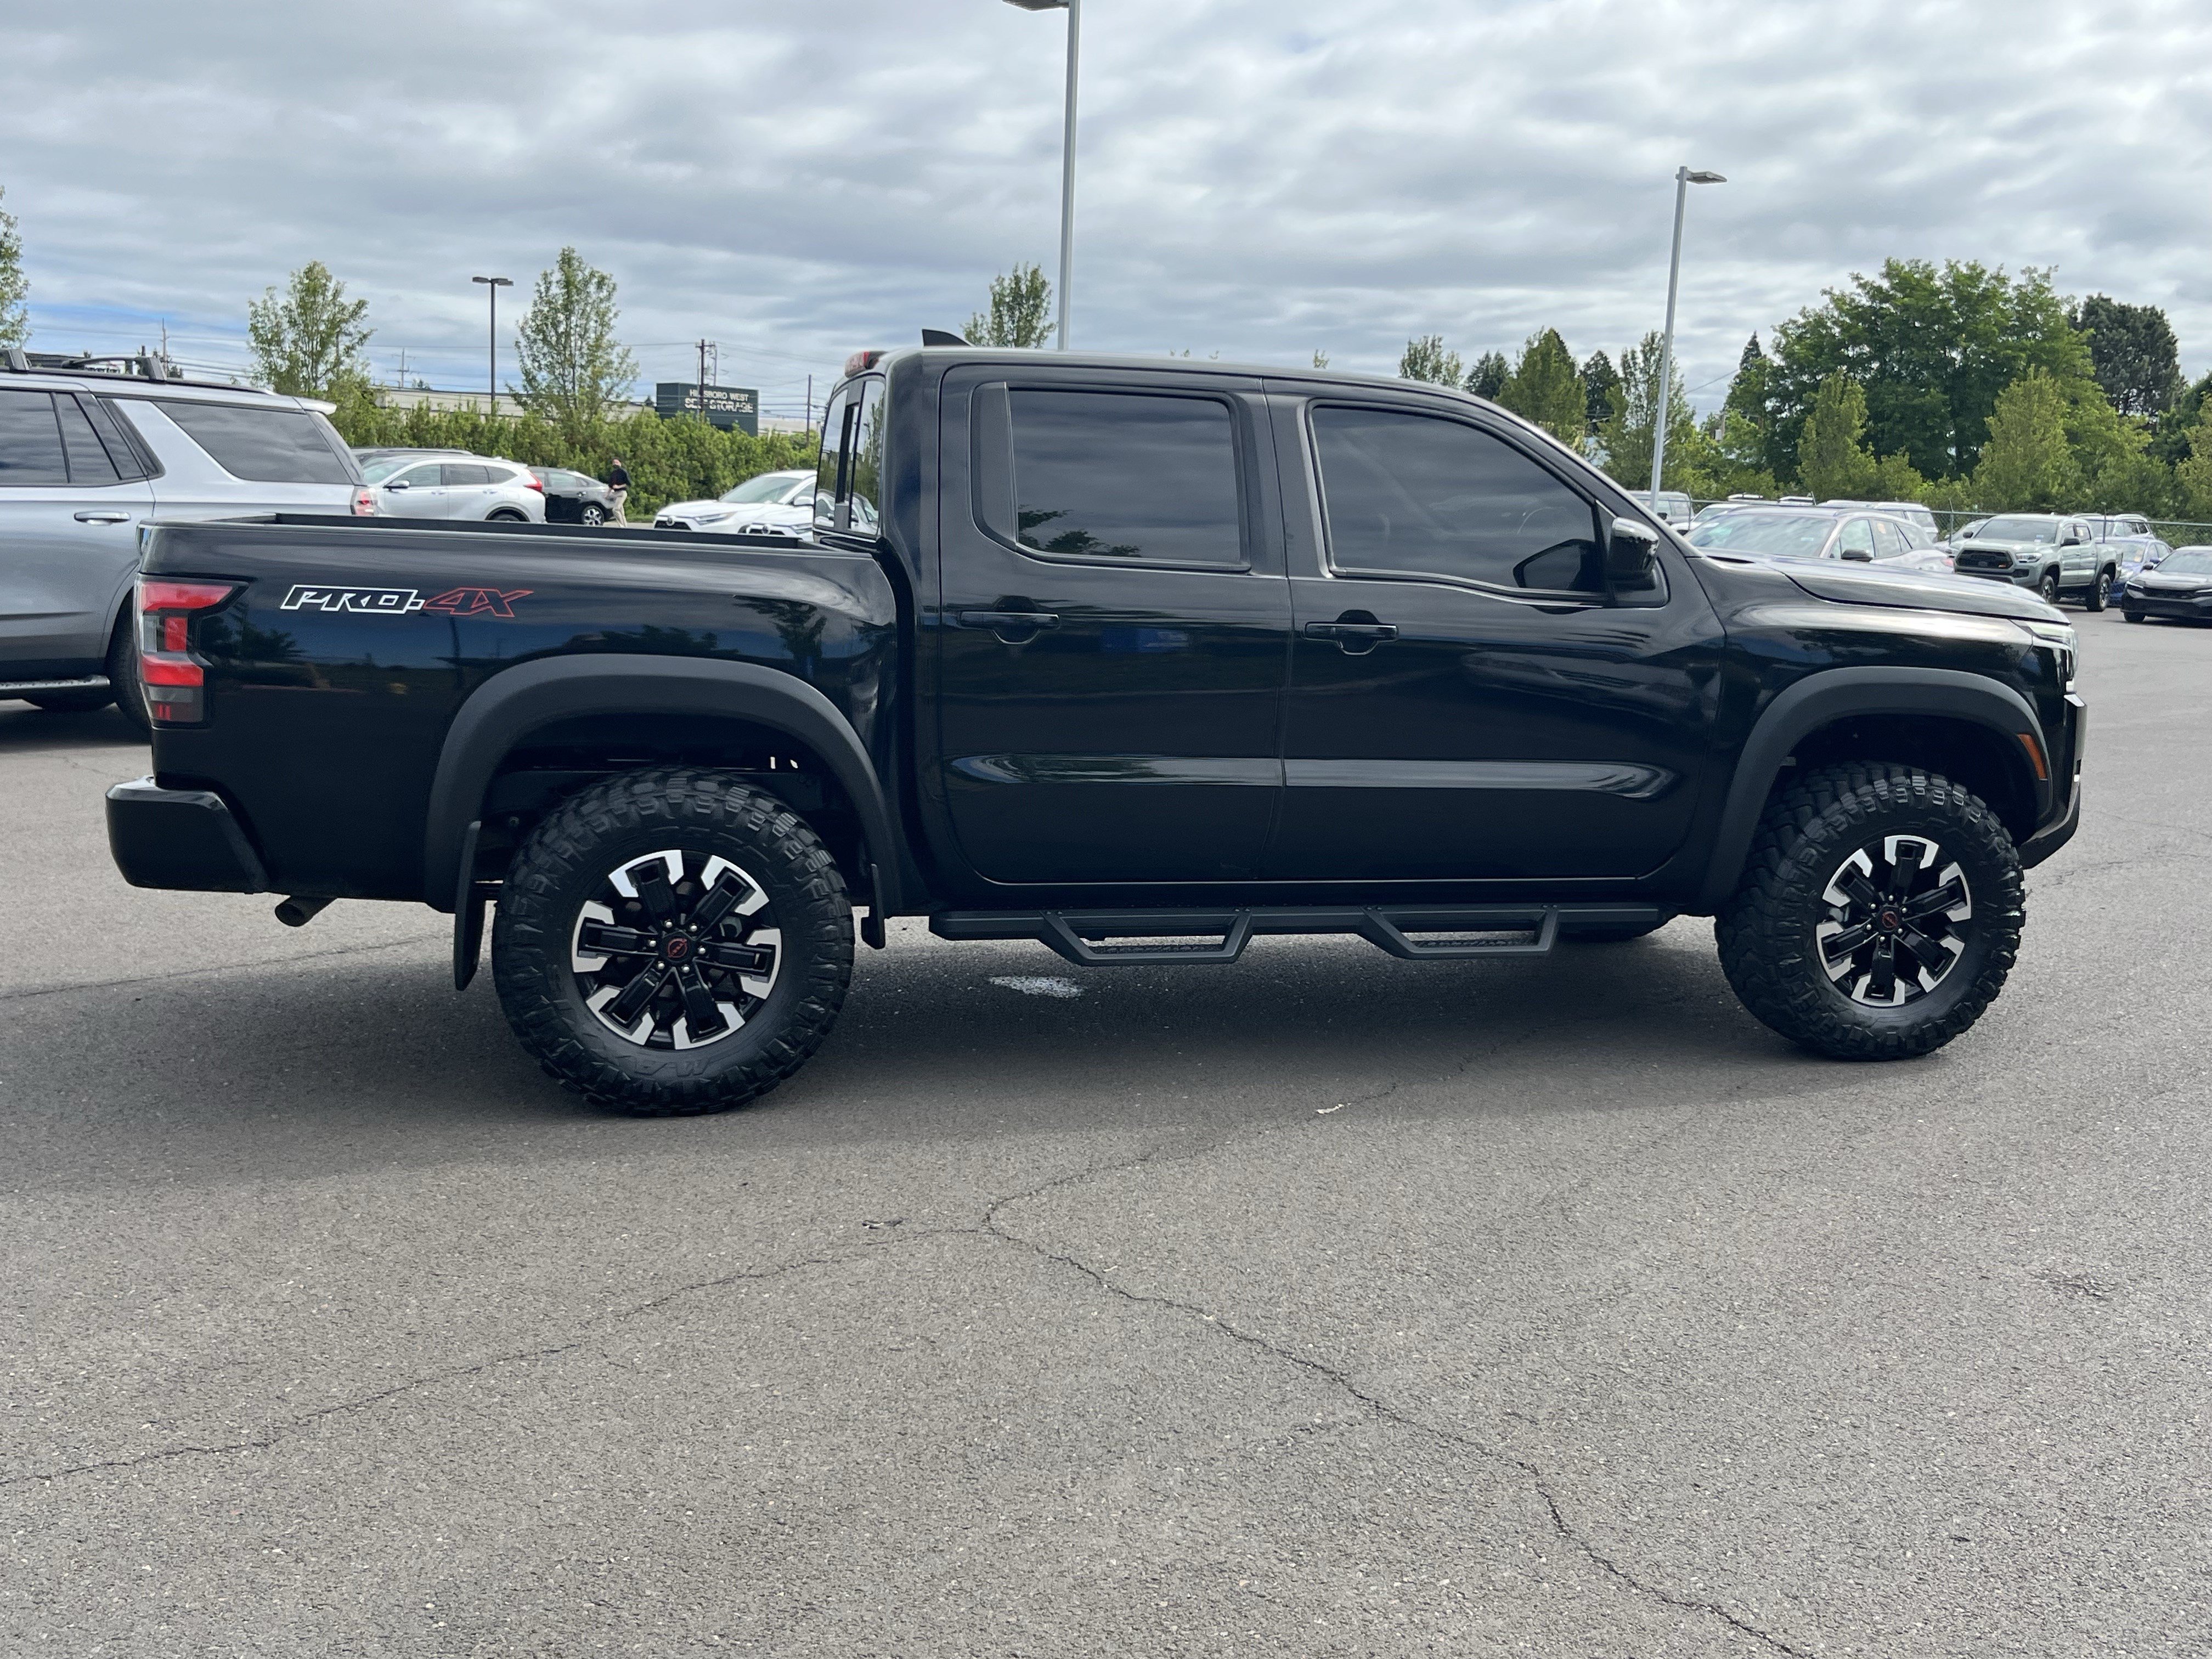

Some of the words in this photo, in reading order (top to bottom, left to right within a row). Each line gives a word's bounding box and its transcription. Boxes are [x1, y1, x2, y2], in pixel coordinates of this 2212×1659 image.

[690, 389, 727, 399] HILSBORO
[730, 393, 749, 401] WEST
[709, 400, 753, 413] STORAGE
